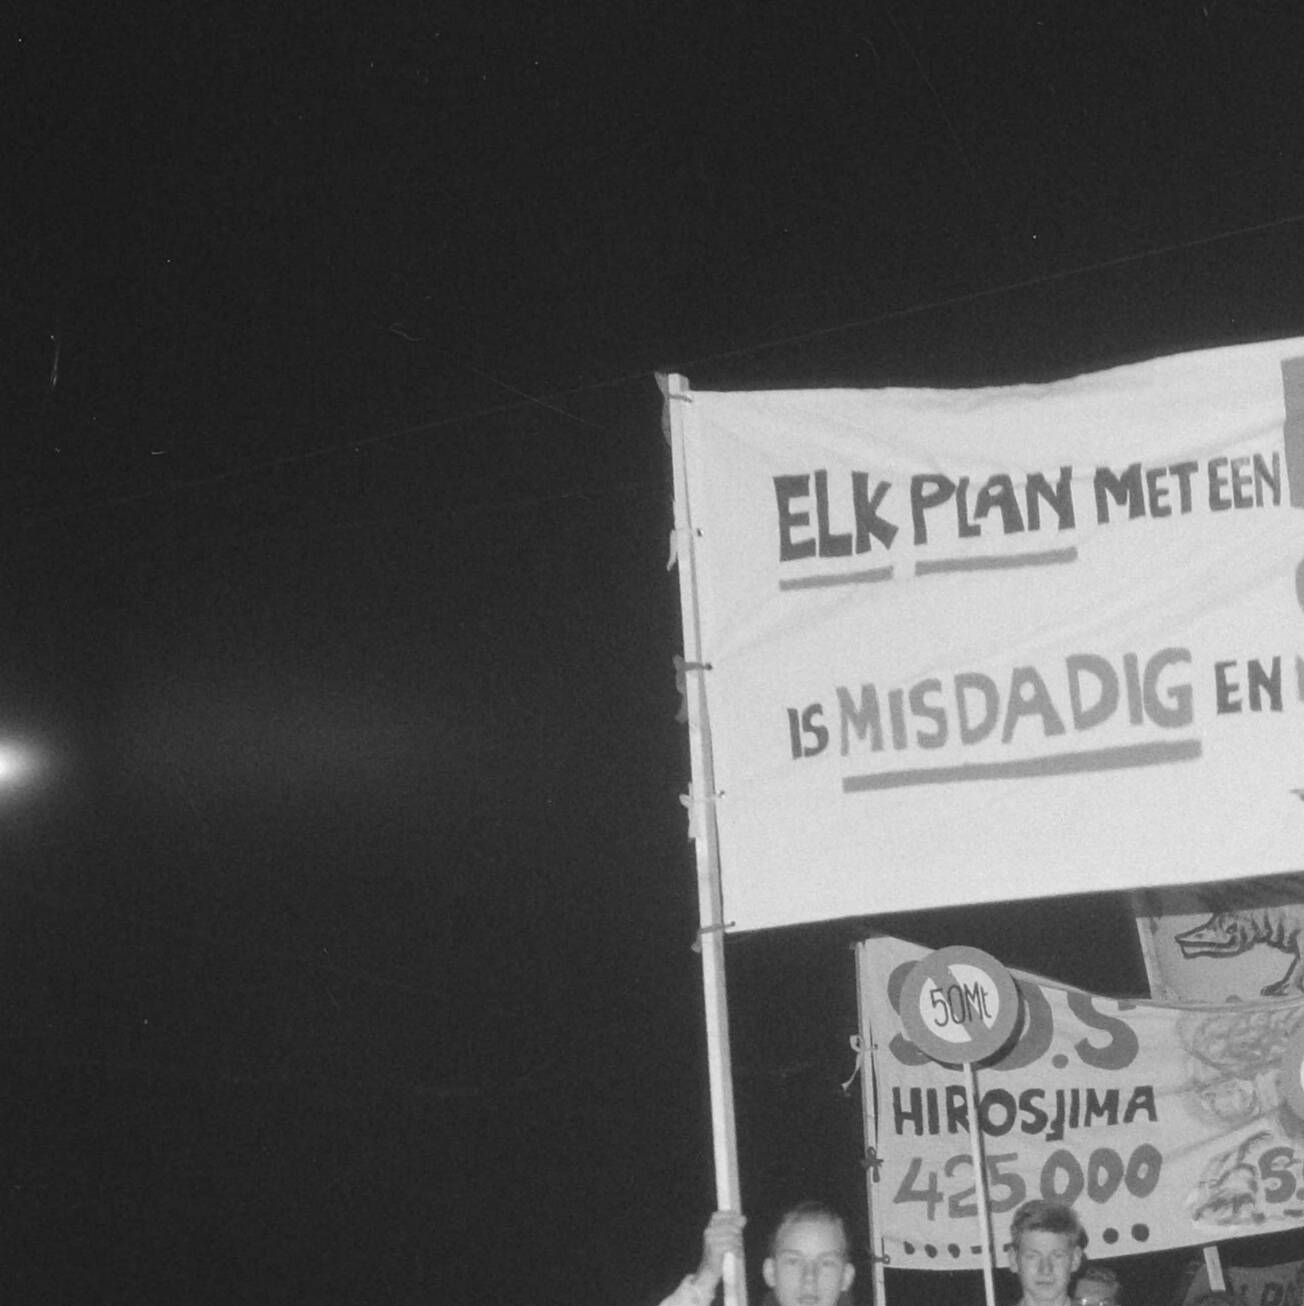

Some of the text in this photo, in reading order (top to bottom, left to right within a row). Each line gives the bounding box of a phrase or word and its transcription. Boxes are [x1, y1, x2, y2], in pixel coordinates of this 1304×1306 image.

[773, 469, 898, 562] ELK
[910, 466, 1076, 546] PLAN
[1093, 462, 1199, 525] MET
[1207, 451, 1281, 512] EEN
[787, 703, 829, 759] IS
[836, 648, 1194, 756] MISDADIG
[1214, 656, 1283, 716] EN
[930, 981, 992, 1027] 50Mt
[892, 1085, 1158, 1142] HIROSJIMA
